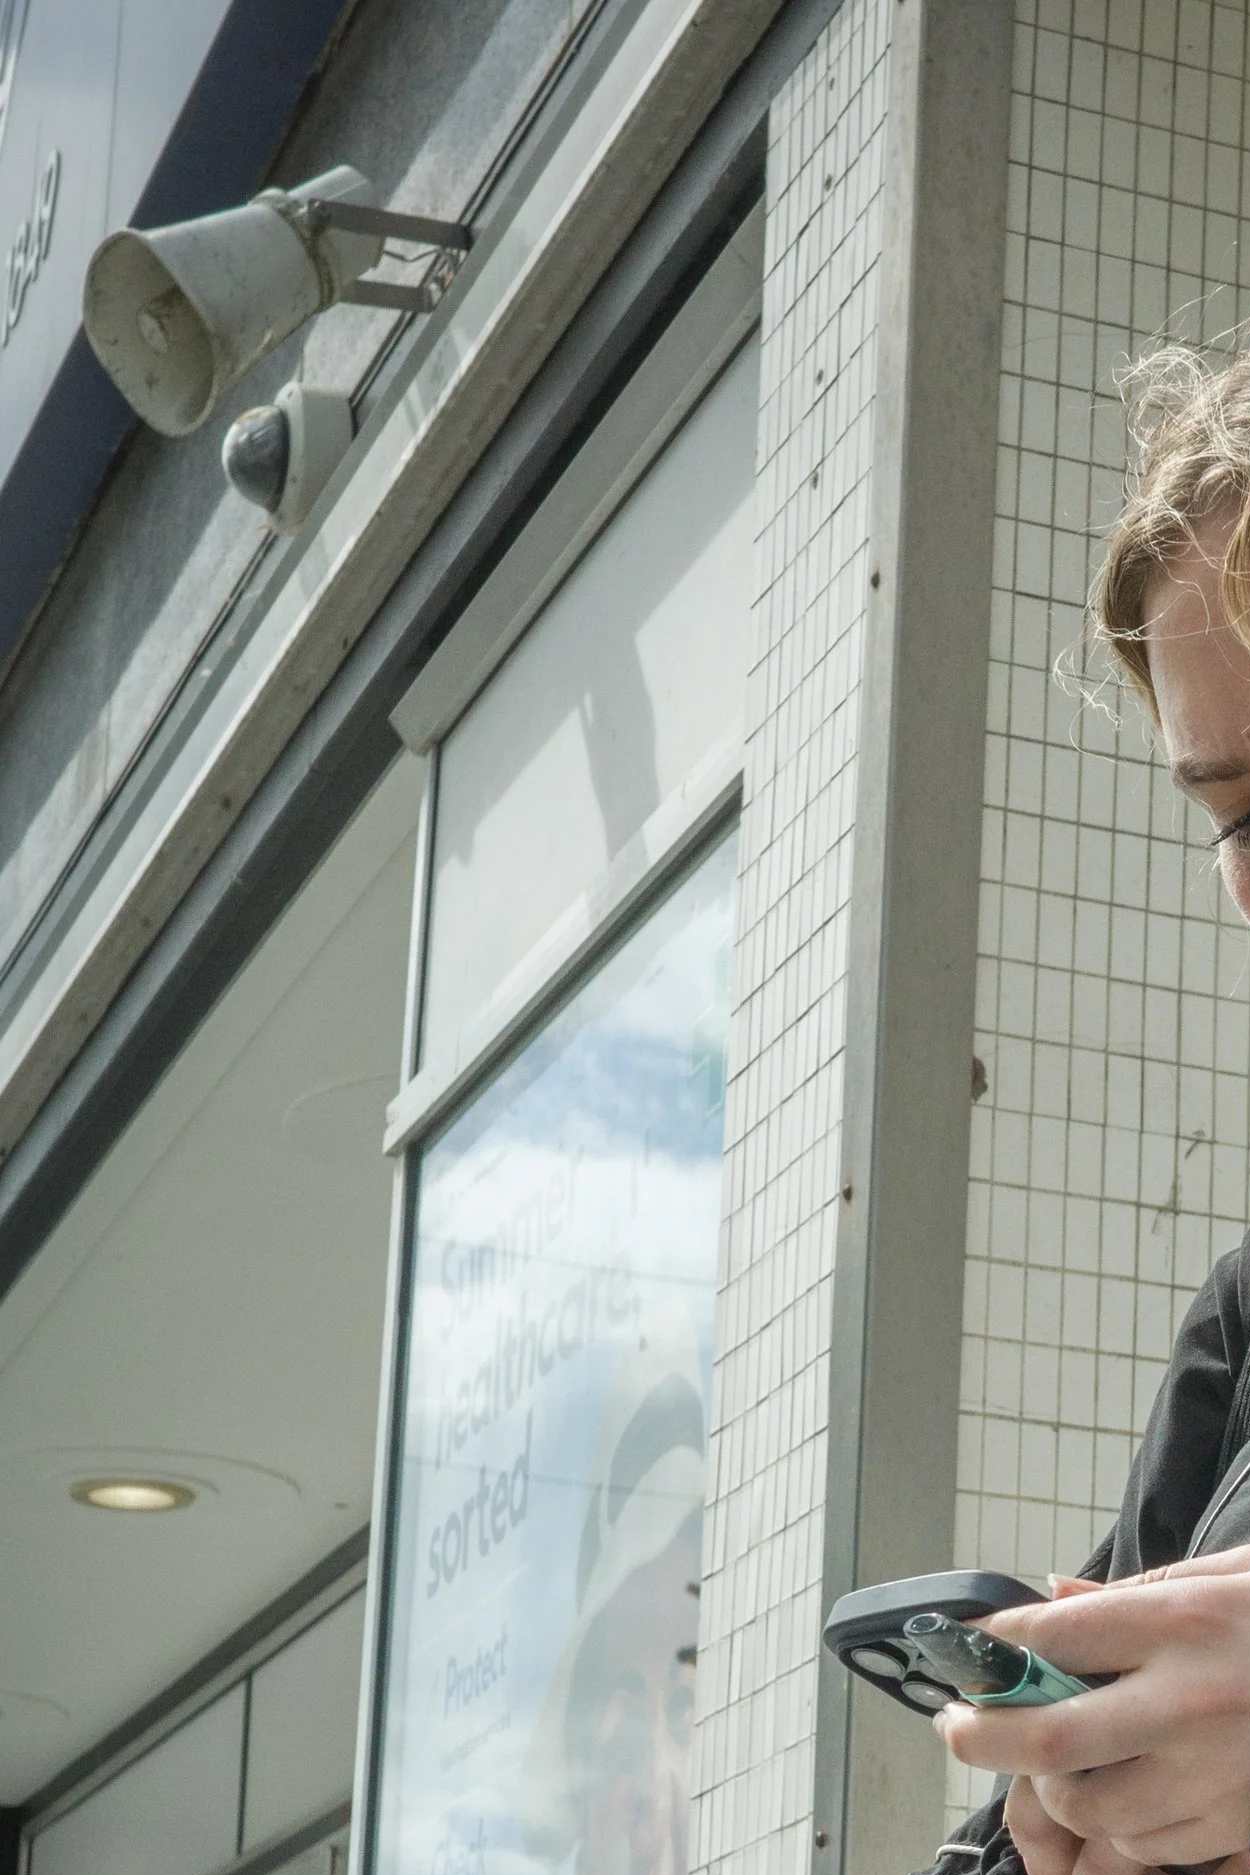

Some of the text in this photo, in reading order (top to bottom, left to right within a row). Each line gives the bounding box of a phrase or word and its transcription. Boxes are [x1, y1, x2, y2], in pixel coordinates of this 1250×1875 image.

[438, 1144, 585, 1340] Summer
[426, 1407, 535, 1601] sorted
[444, 1622, 508, 1722] Protect
